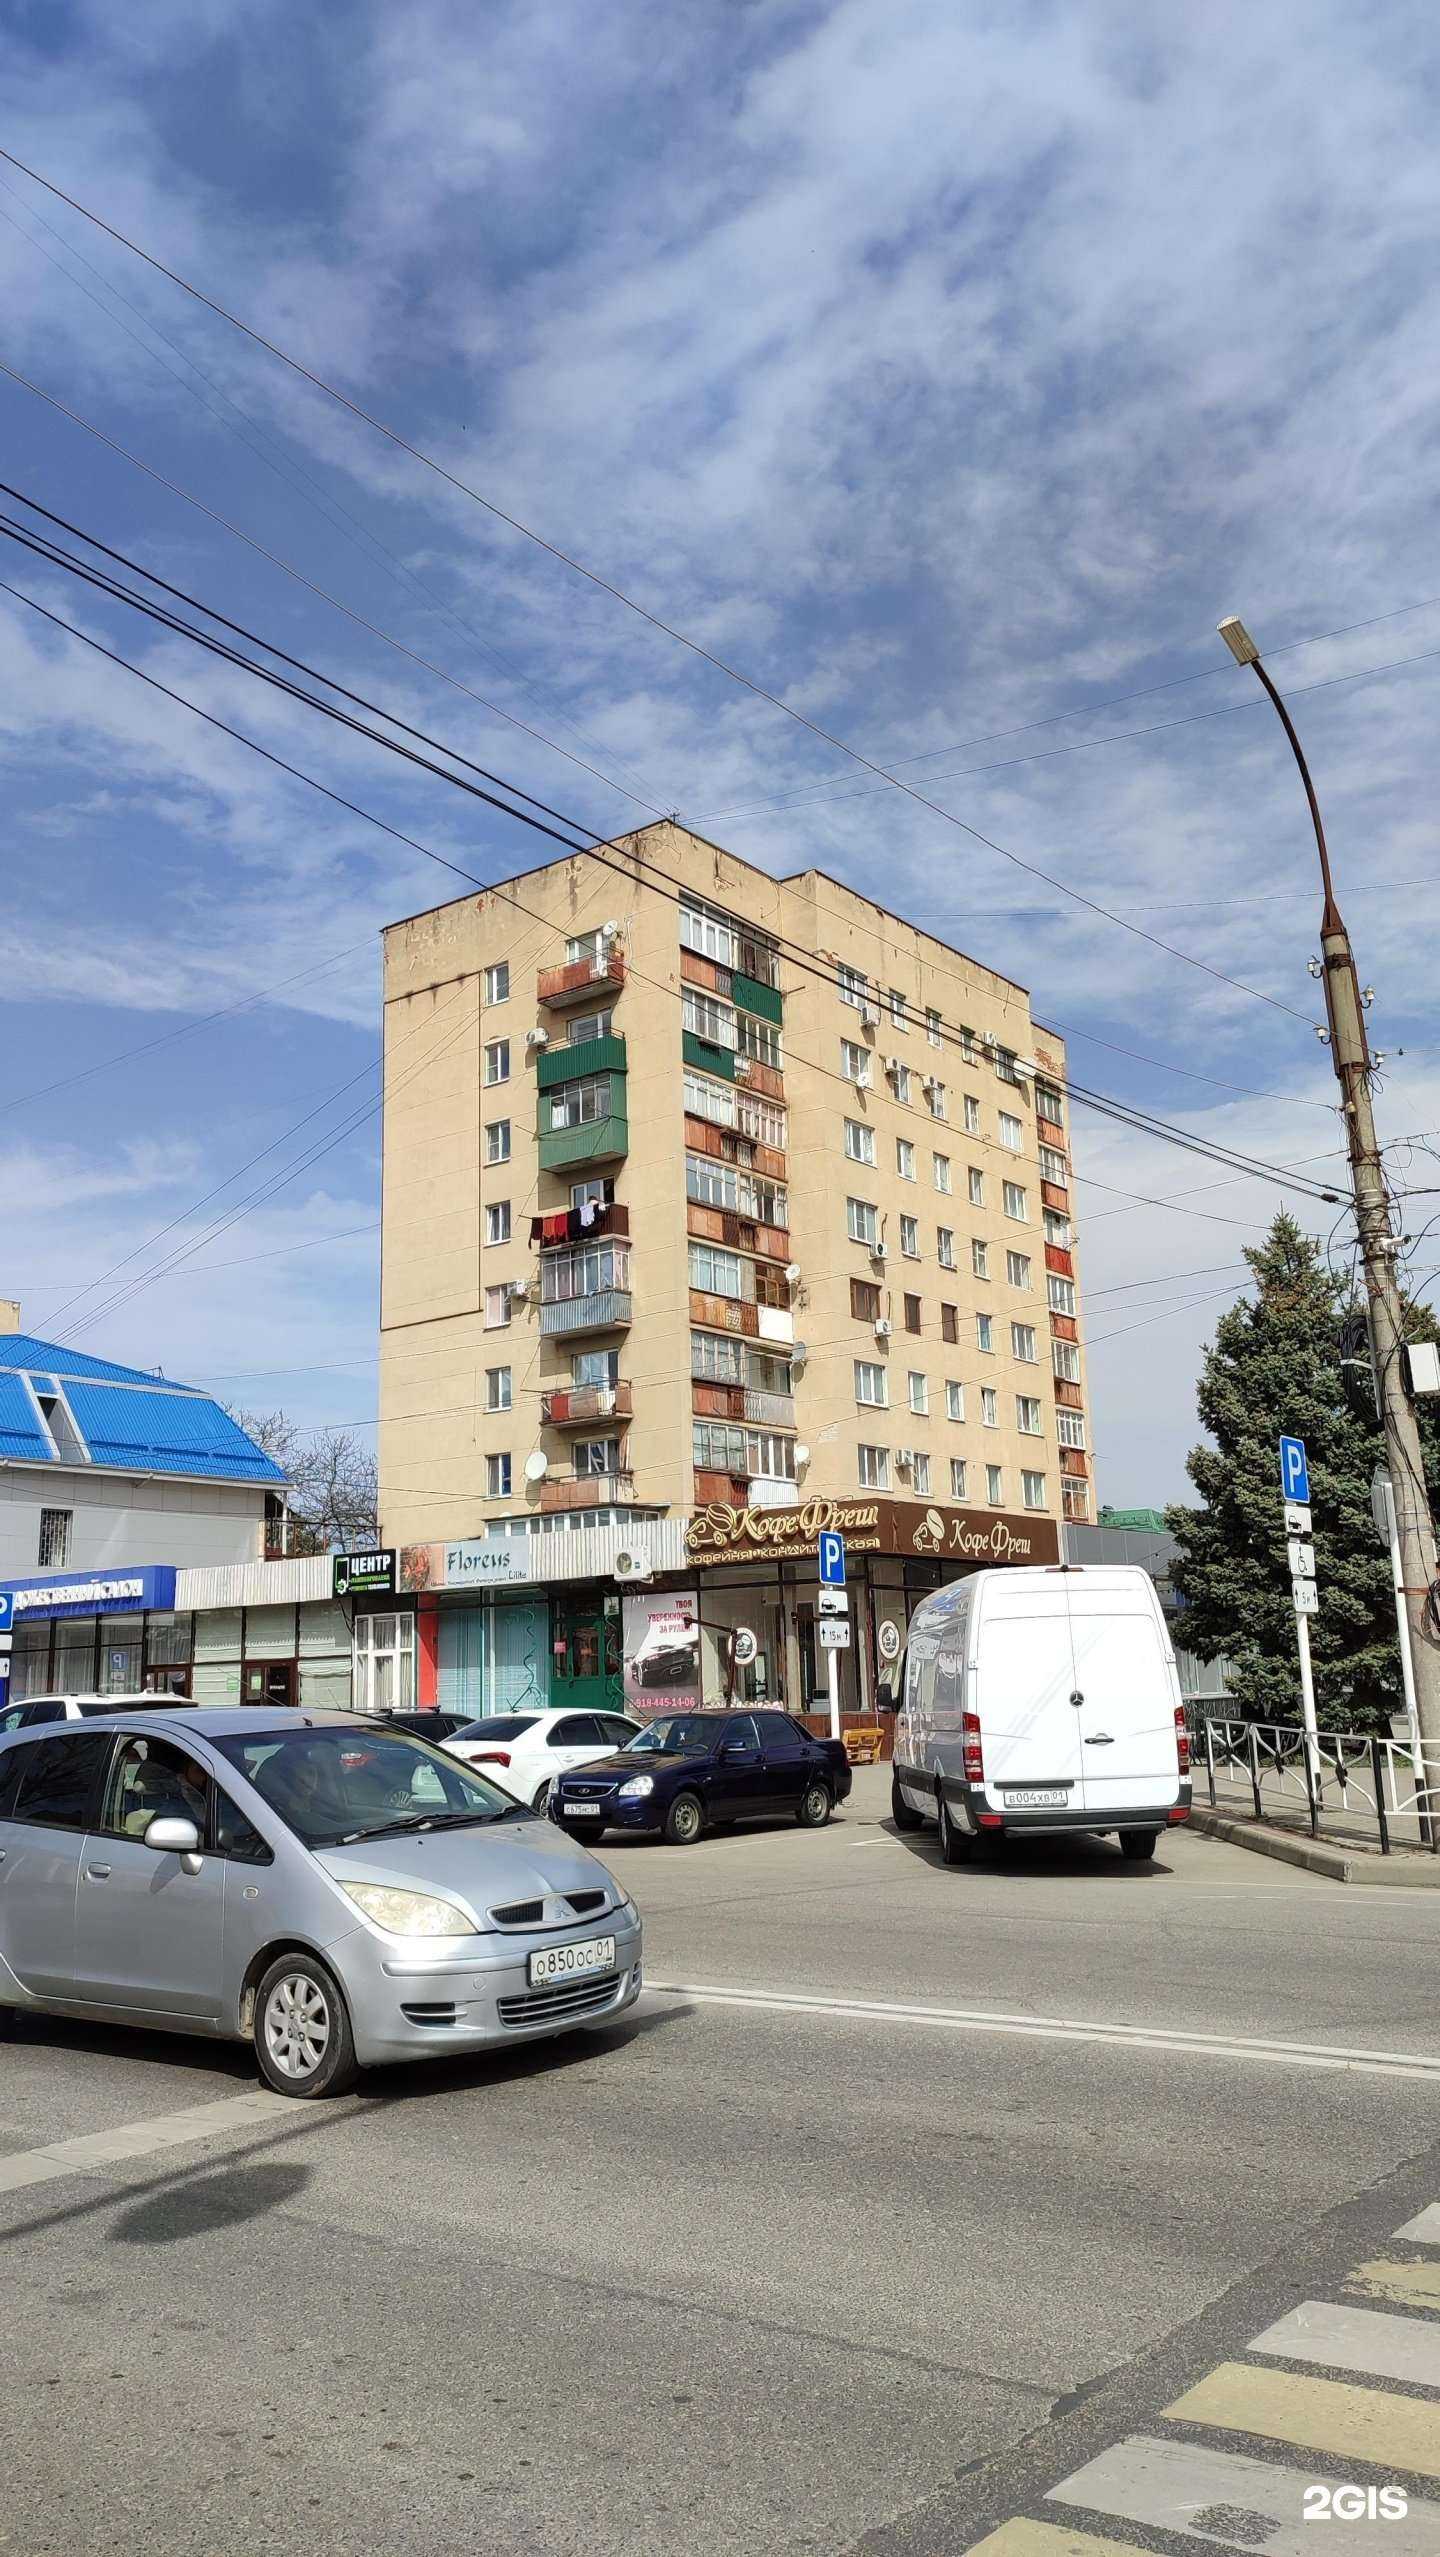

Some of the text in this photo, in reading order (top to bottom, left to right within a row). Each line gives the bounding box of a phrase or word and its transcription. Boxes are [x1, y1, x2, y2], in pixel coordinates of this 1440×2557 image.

[1287, 1446, 1302, 1493] P
[731, 1500, 879, 1543] Кофе Фреш
[949, 1519, 1031, 1560] Кофе Фреш
[351, 1555, 391, 1576] ЦЕНТР
[686, 1537, 880, 1567] кофейня кондиткая
[825, 1538, 839, 1578] P
